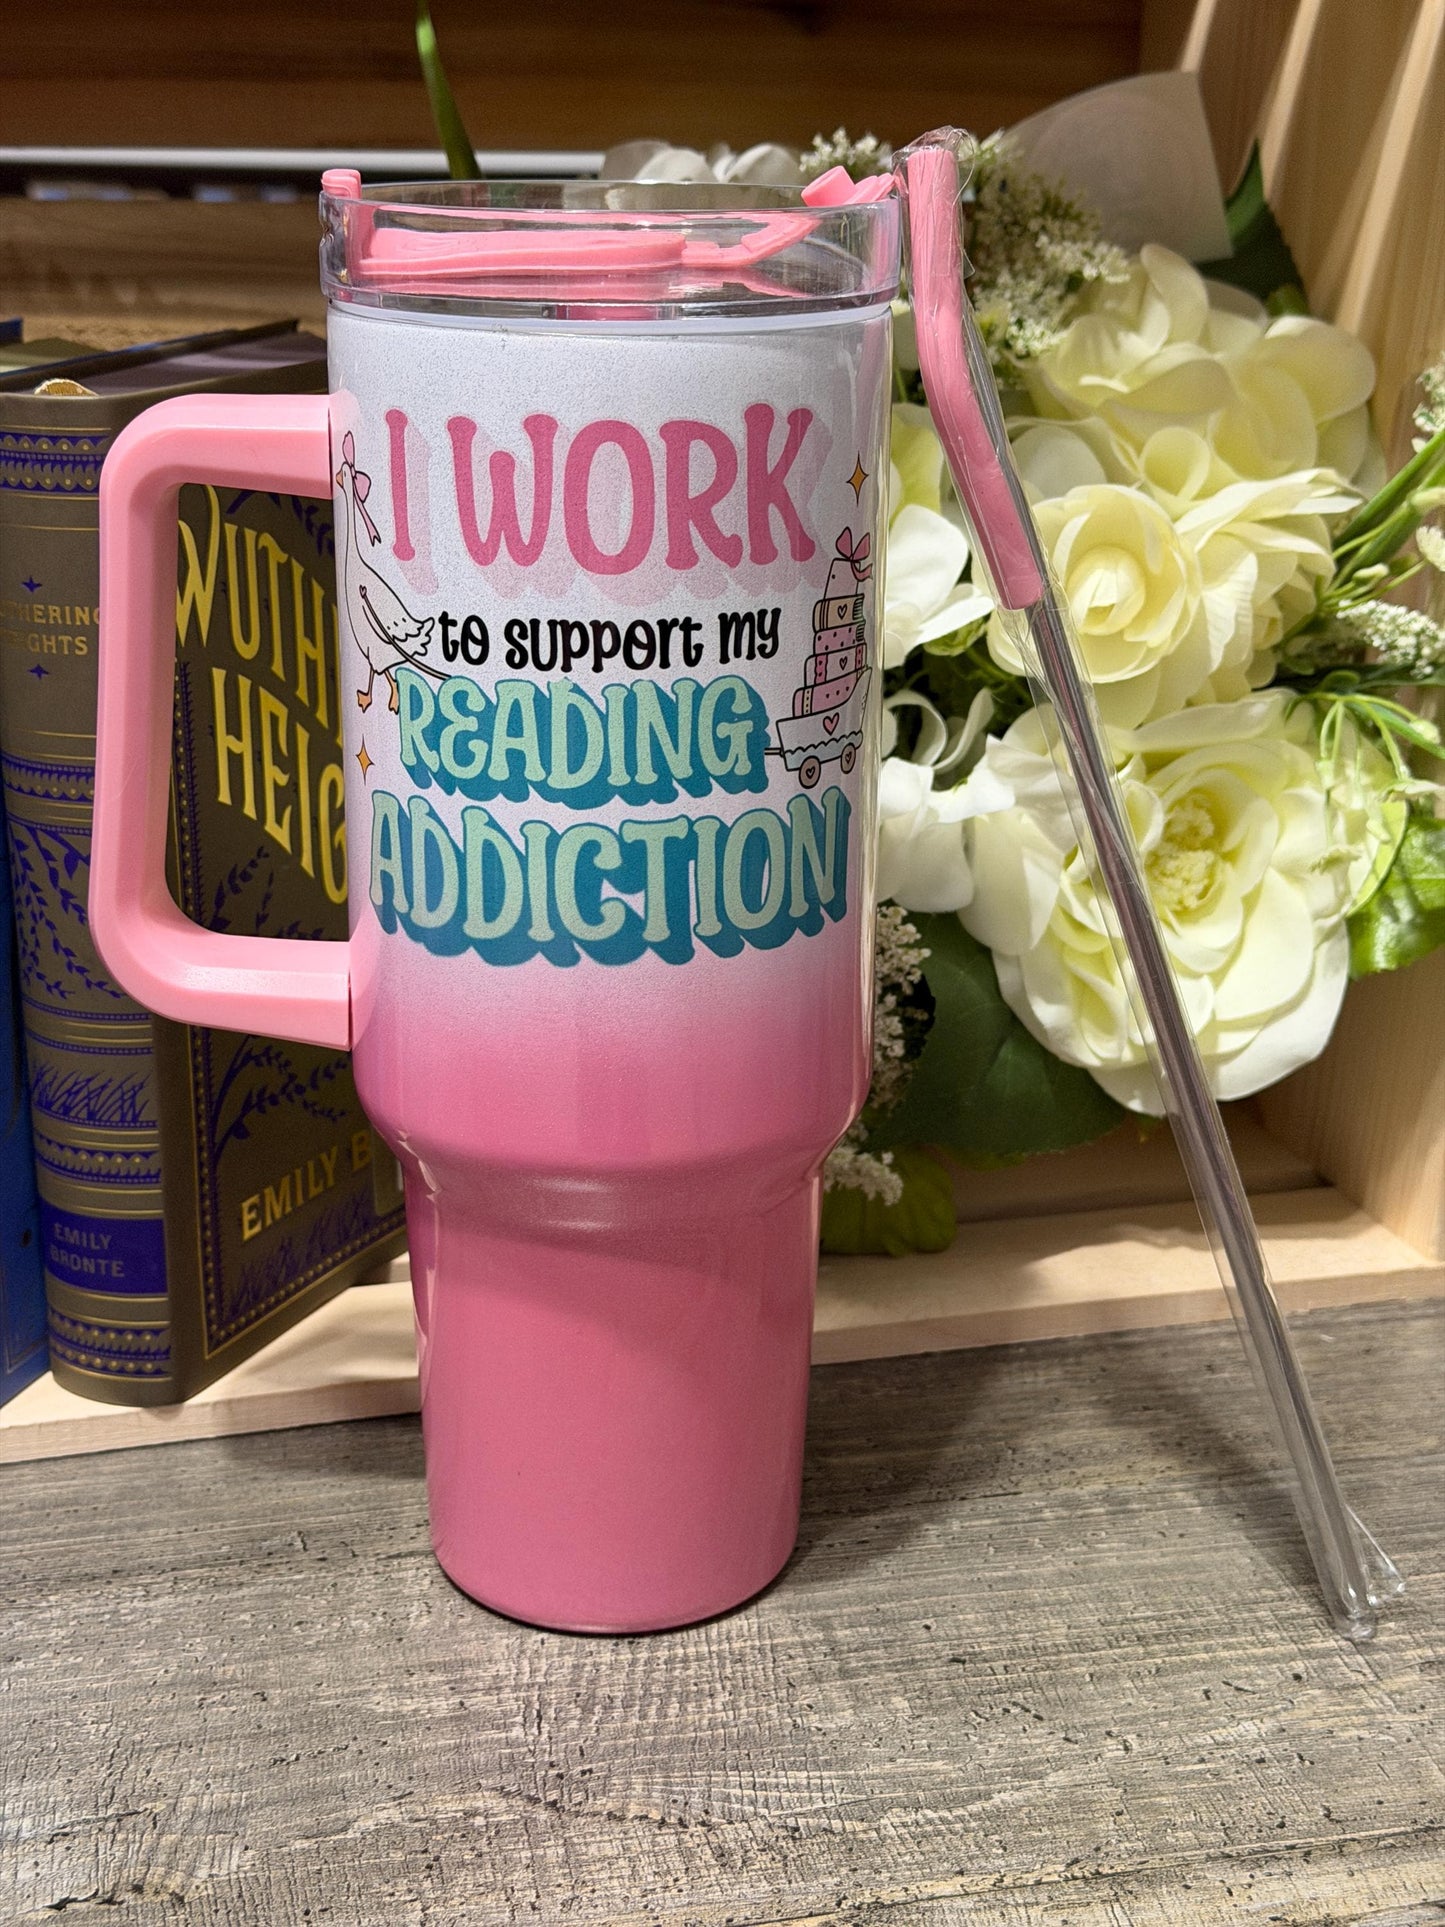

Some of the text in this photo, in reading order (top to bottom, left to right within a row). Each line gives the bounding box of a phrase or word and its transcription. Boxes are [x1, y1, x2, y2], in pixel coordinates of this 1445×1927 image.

[384, 402, 817, 576] I WORK
[176, 484, 343, 748] WUTH
[438, 607, 782, 673] to support my
[396, 667, 768, 807] READING
[367, 787, 851, 966] ADDICTION
[54, 1222, 112, 1250] EMILY
[241, 1145, 338, 1241] EMILY
[50, 1243, 125, 1278] BRONTE
